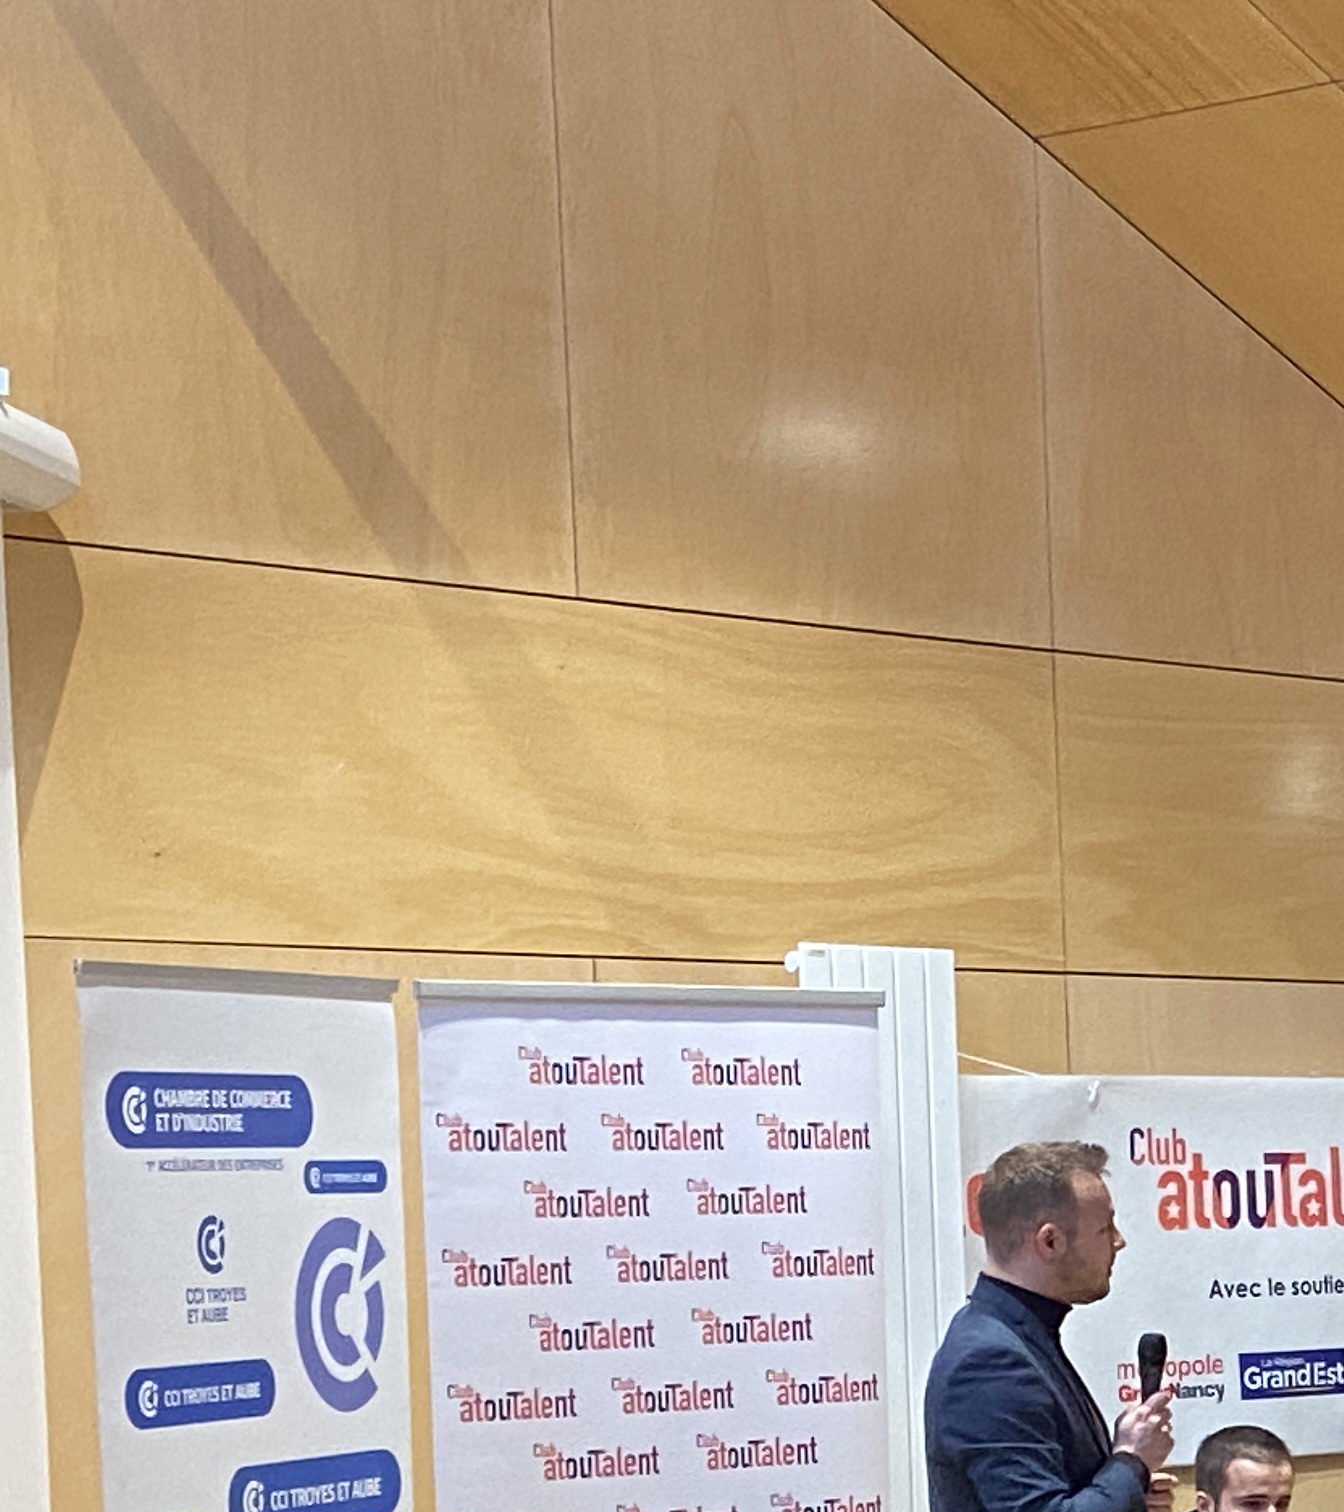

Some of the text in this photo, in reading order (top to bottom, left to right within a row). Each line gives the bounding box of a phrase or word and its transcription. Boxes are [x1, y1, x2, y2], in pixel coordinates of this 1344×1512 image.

[529, 1055, 644, 1085] atouTalent
[692, 1057, 801, 1086] atouTalent
[212, 1089, 228, 1109] DE
[156, 1113, 170, 1132] ET
[448, 1122, 567, 1152] atouTalent
[612, 1121, 724, 1151] atouTalent
[767, 1121, 870, 1150] atouTalent
[1129, 1126, 1186, 1166] Club
[535, 1188, 649, 1218] atouTalent
[697, 1186, 807, 1214] atouTalent
[454, 1256, 571, 1287] atouTalent
[617, 1252, 729, 1282] atouTalent
[772, 1248, 874, 1278] atouTalent
[1209, 1278, 1261, 1299] Avec
[1268, 1277, 1286, 1298] le
[540, 1320, 655, 1351] atouTalent
[702, 1314, 812, 1345] atouTalent
[1117, 1354, 1224, 1381] mopole
[1243, 1361, 1344, 1390] Grand Est
[622, 1382, 734, 1414] atouTalent
[776, 1374, 878, 1405] atouTalent
[460, 1389, 576, 1422] atouTalent
[544, 1446, 659, 1480] atouTalent
[707, 1437, 817, 1470] atouTalent
[270, 1490, 289, 1511] CCI
[290, 1482, 336, 1508] TROYES
[337, 1480, 351, 1502] ET
